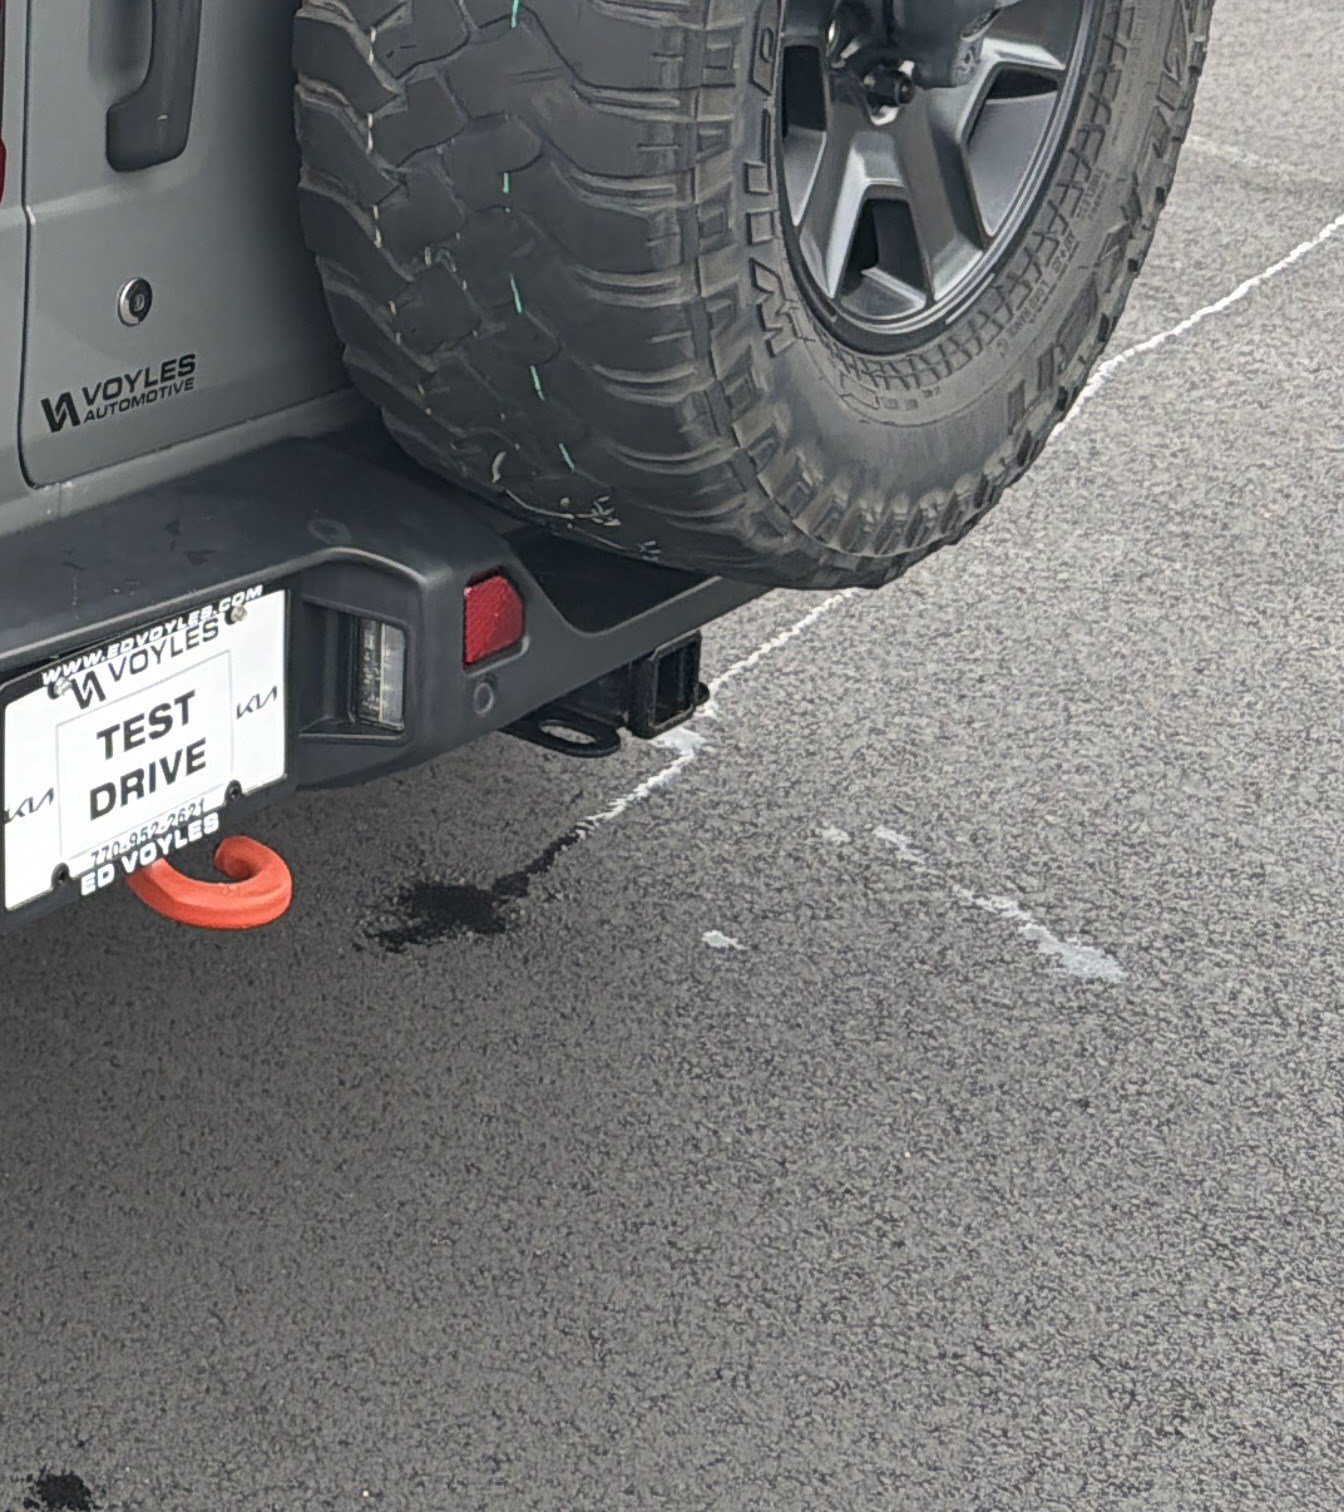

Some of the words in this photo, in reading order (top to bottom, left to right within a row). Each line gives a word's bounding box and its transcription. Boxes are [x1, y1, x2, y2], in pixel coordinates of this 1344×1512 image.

[82, 353, 197, 407] VOYLES
[83, 377, 194, 423] AUTOMOTIVE
[41, 584, 264, 686] WWW.EDVOYLES.COM
[107, 617, 219, 683] VOYLES
[96, 690, 196, 761] TEST
[89, 738, 207, 821] DRIVE
[80, 863, 116, 896] ED
[121, 812, 220, 874] VOYLES
[90, 797, 205, 864] 770-952-2621
